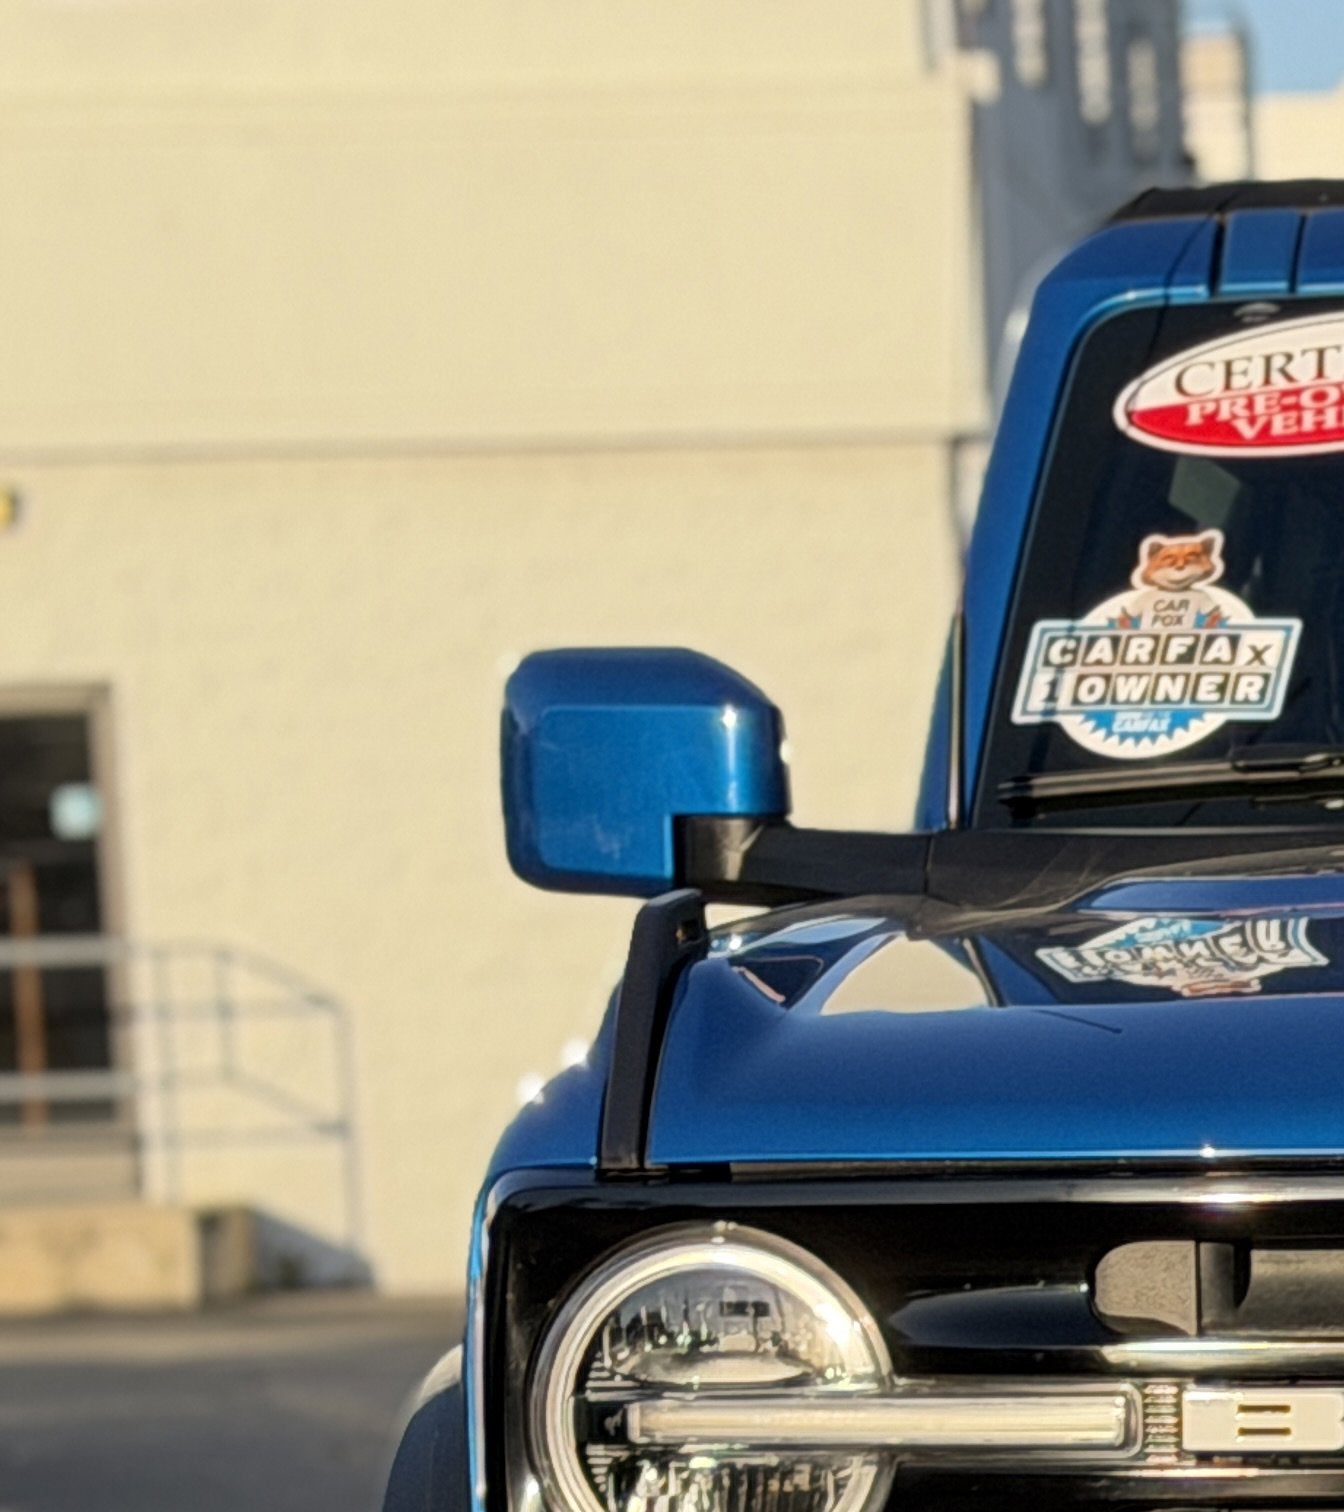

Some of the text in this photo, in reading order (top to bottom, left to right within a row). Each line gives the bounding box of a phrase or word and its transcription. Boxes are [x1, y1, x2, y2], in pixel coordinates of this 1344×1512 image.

[1152, 599, 1189, 613] CAR
[1151, 613, 1185, 627] FOX
[1047, 635, 1273, 666] CARFAX
[1076, 674, 1266, 704] OWNER
